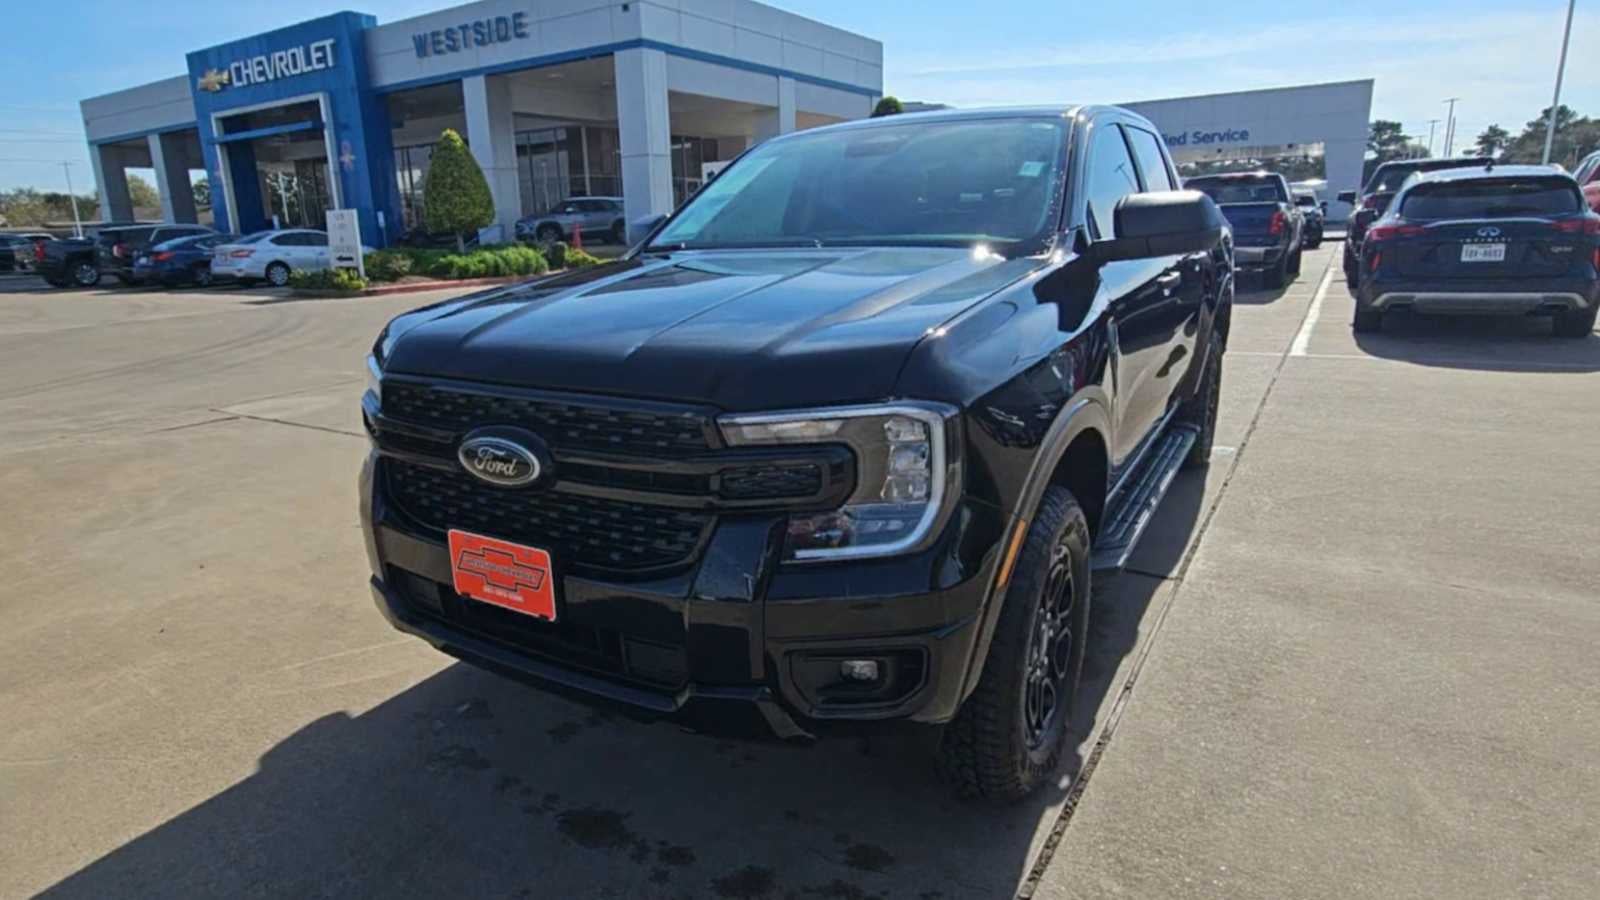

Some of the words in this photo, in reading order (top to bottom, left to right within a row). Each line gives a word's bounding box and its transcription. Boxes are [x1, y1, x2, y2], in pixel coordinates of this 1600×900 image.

[412, 11, 529, 59] WESTSIDE
[230, 38, 335, 88] CHEVROLET
[1192, 127, 1250, 144] Service
[474, 446, 518, 476] Ford
